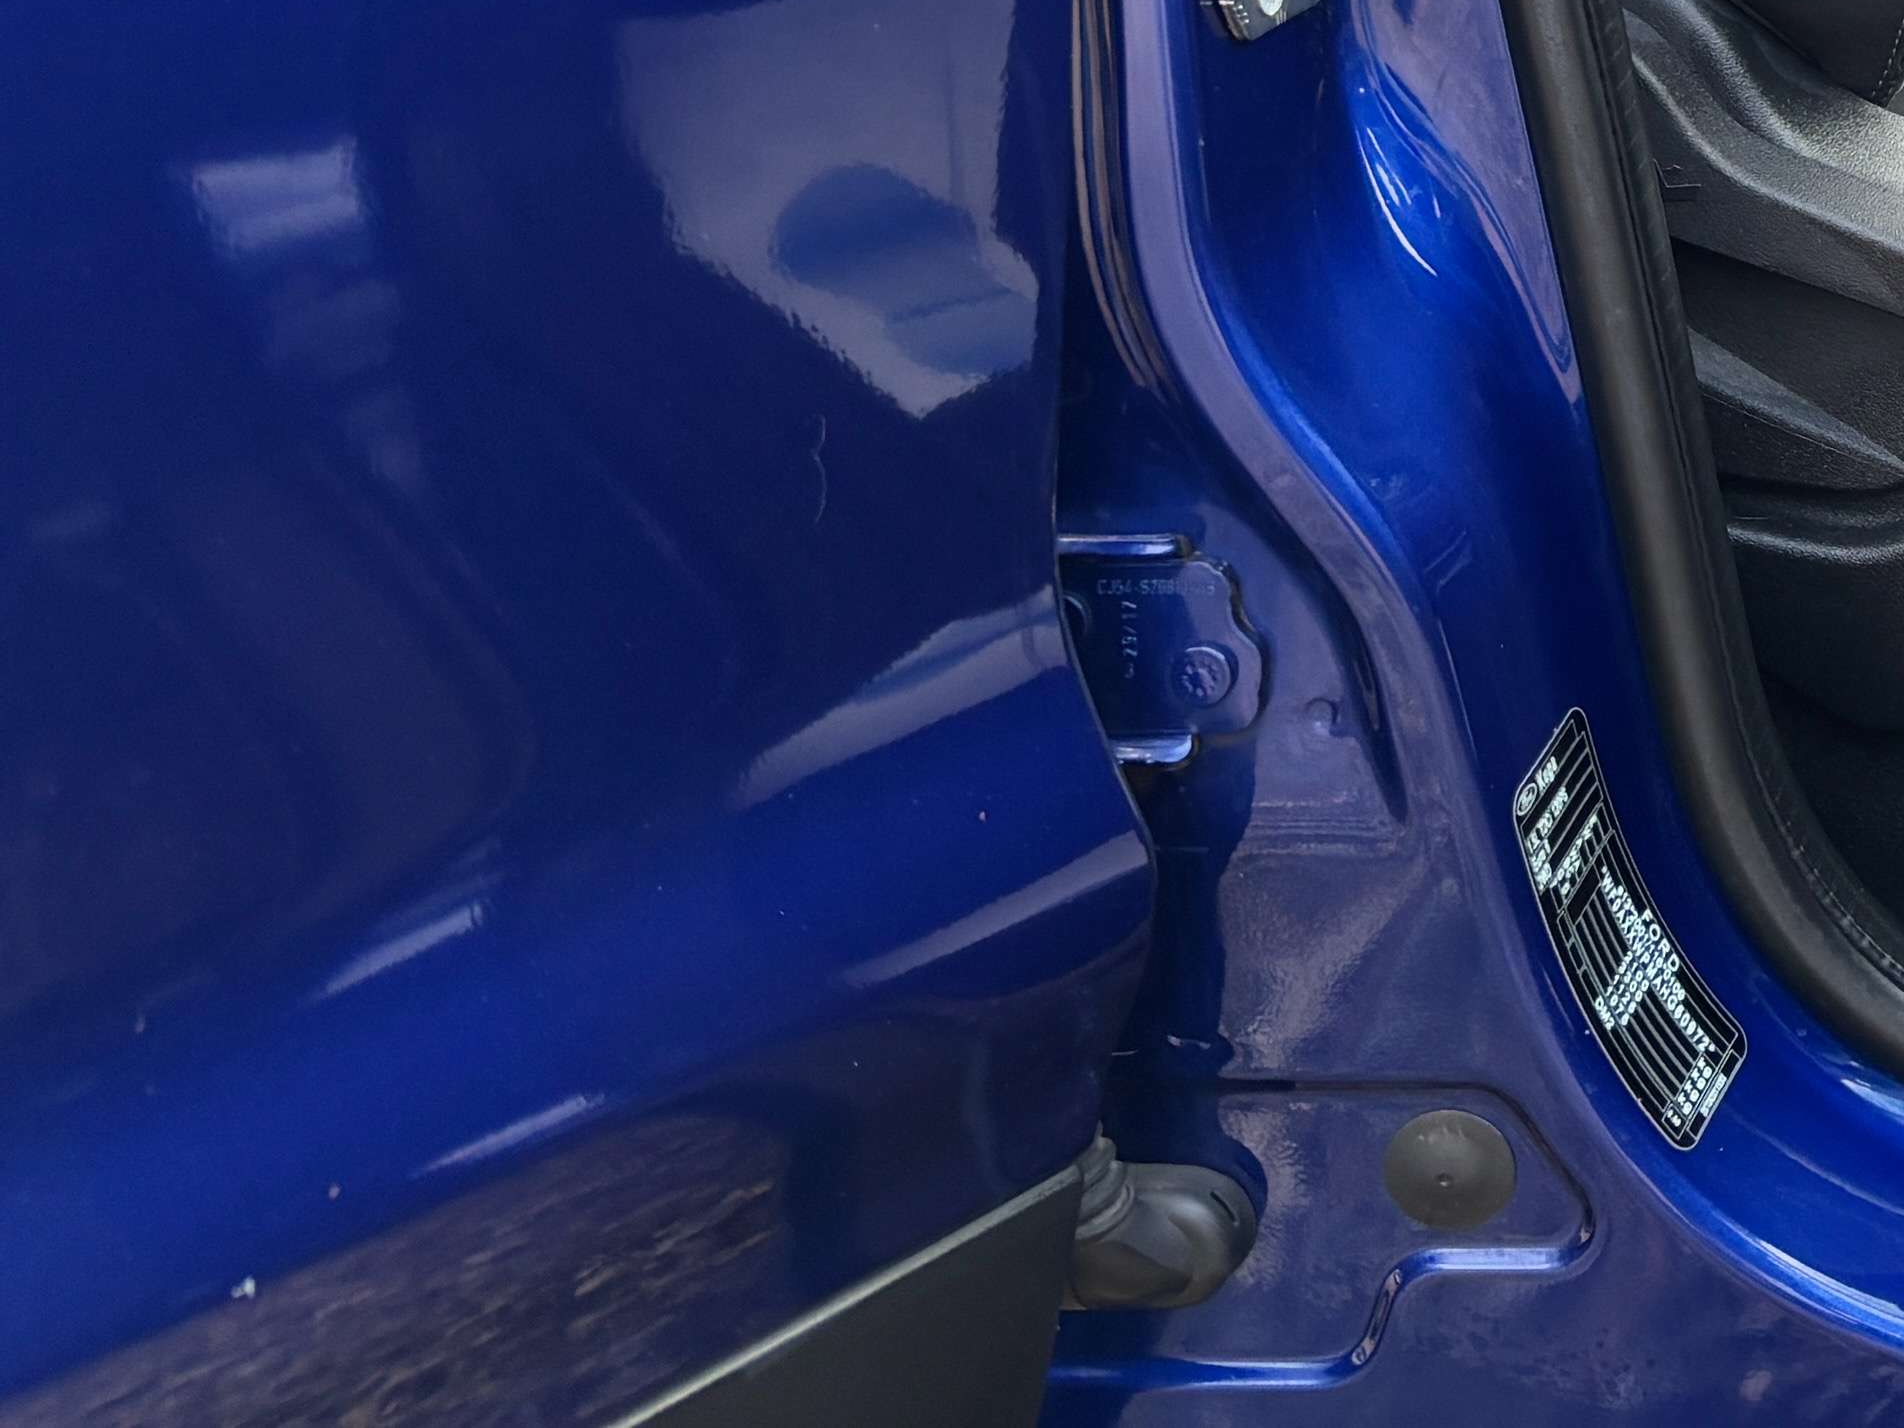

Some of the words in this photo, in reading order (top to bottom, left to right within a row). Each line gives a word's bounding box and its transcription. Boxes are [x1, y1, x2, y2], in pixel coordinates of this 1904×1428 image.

[1641, 908, 1680, 972] FORD
[1624, 951, 1649, 991] 2100
[1594, 995, 1615, 1031] DM2
